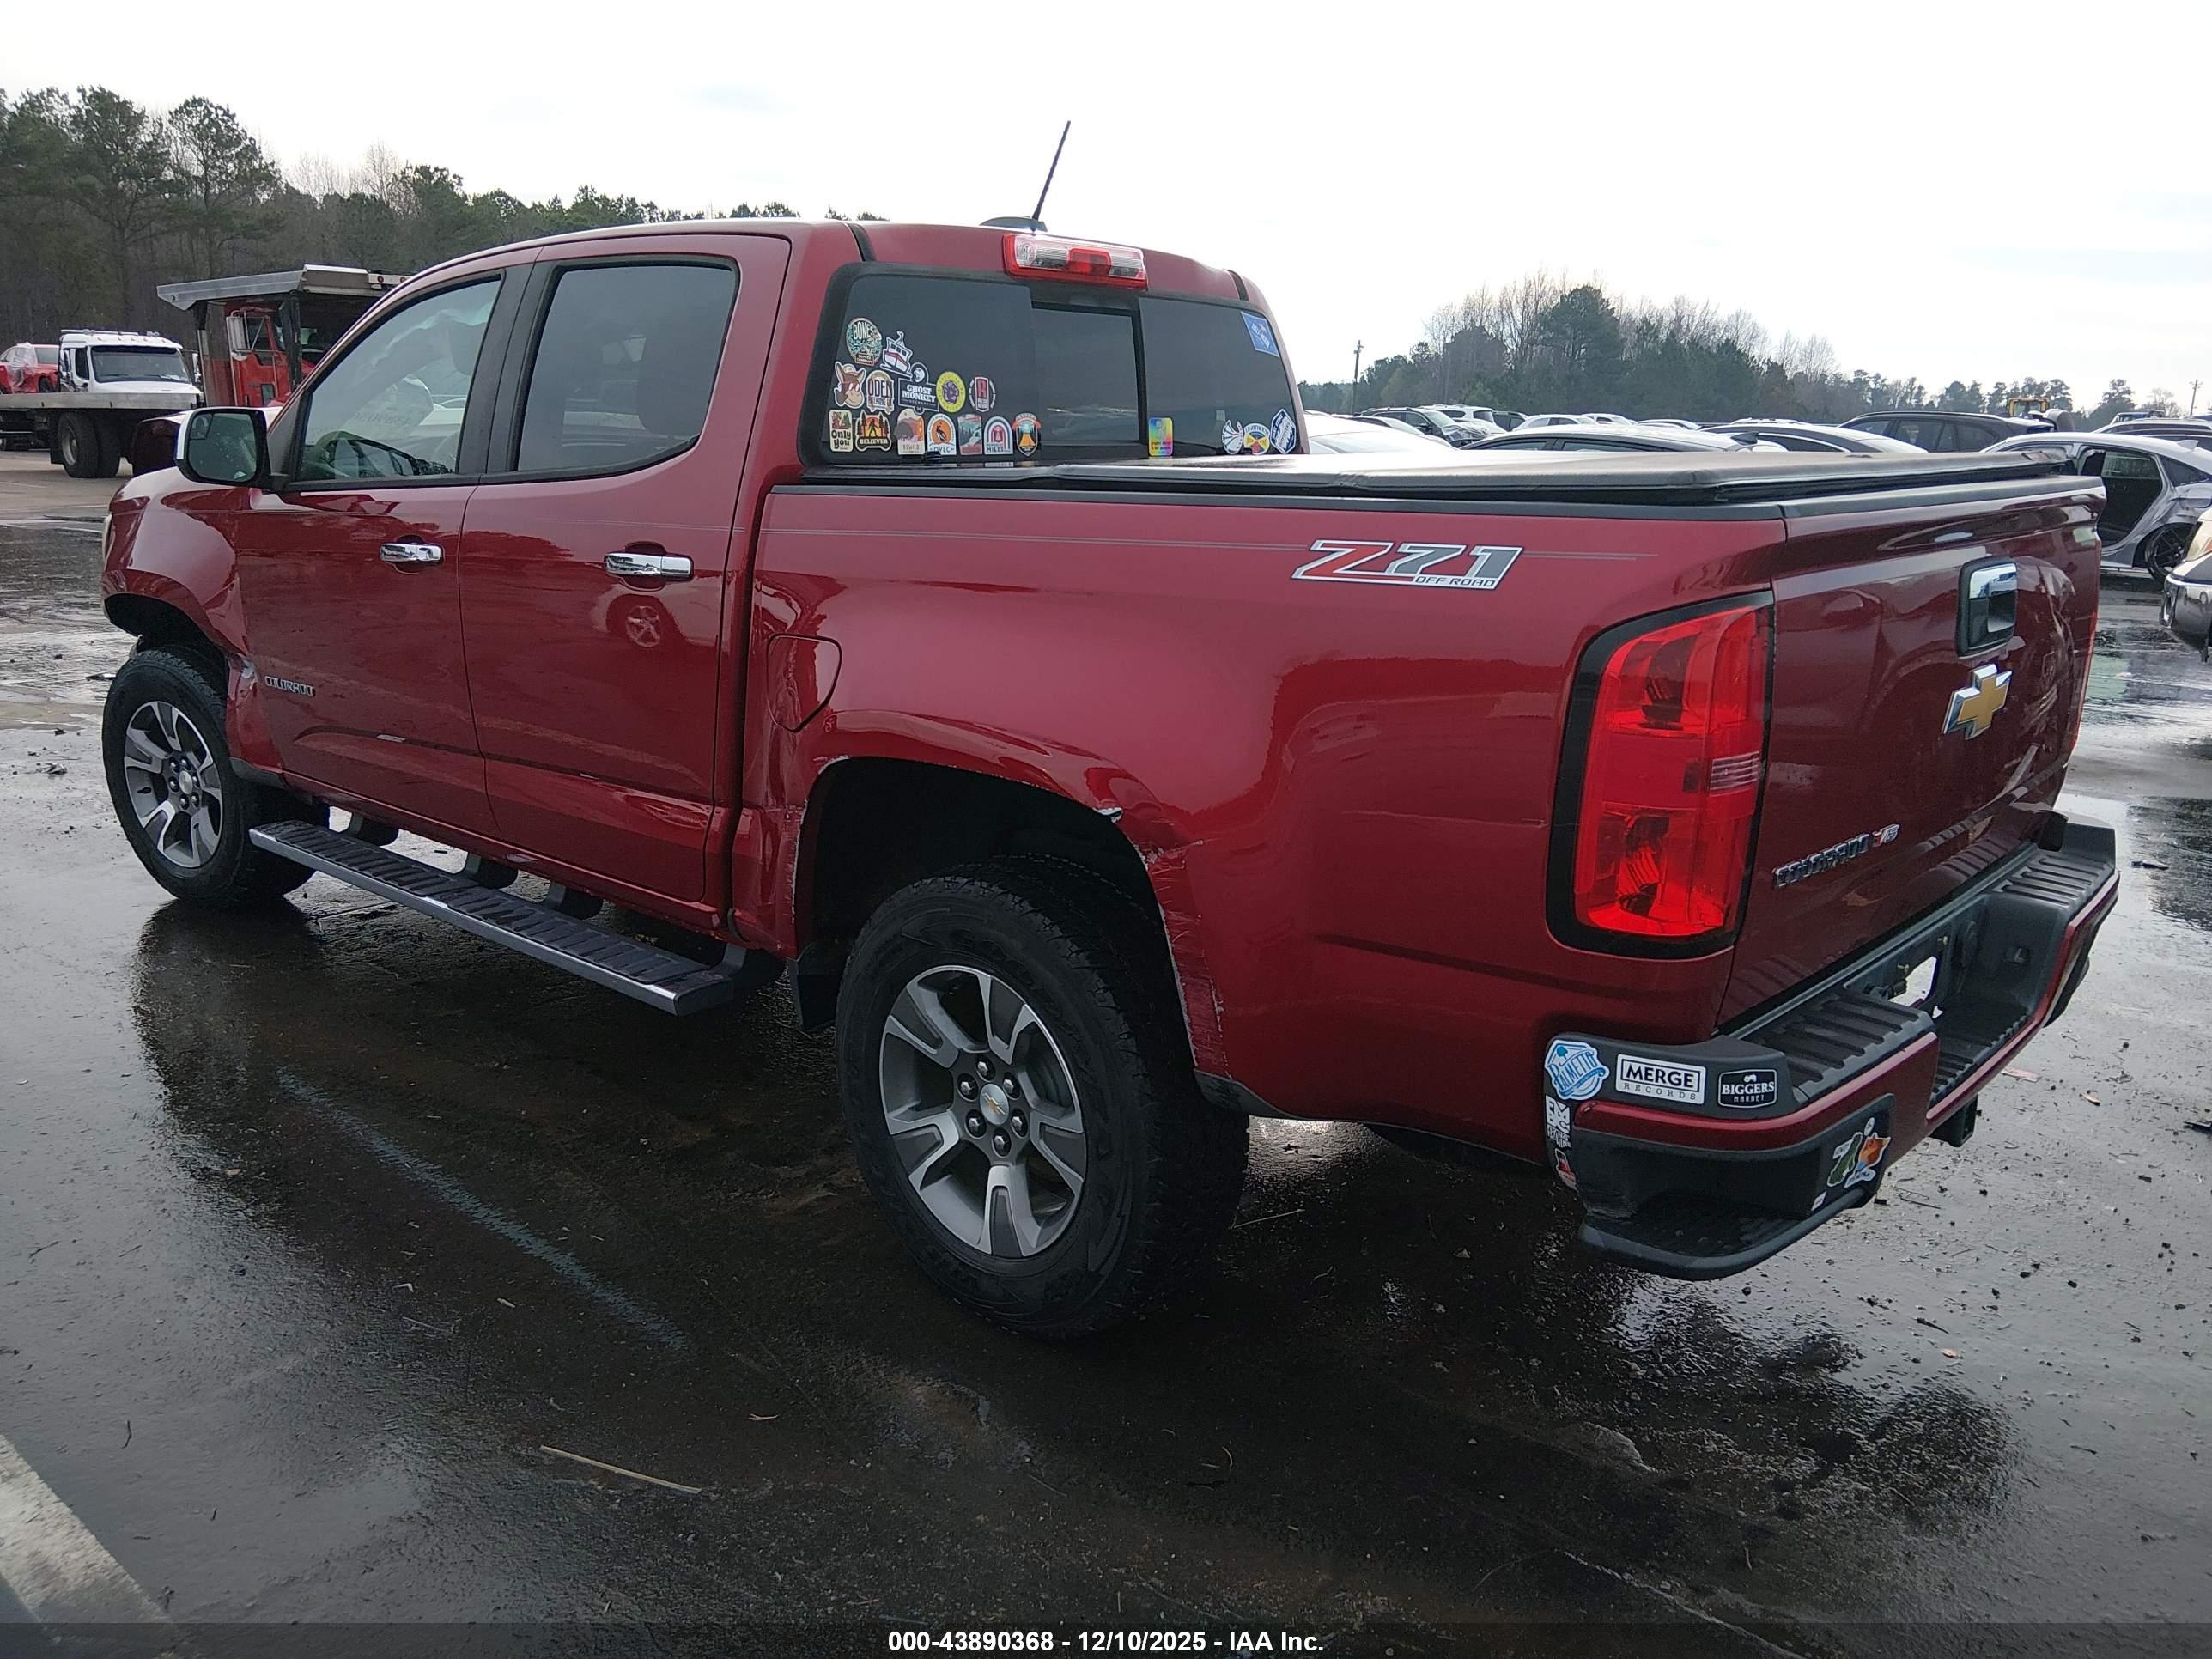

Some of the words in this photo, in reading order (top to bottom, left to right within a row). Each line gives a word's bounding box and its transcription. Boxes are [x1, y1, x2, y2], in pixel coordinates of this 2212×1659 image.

[853, 321, 874, 340] BONES
[902, 390, 936, 403] MONKEY
[907, 384, 932, 395] GHOST
[831, 429, 851, 440] Only
[834, 439, 850, 449] you
[1291, 539, 1523, 589] Z71
[1414, 575, 1447, 585] OFF
[1449, 578, 1497, 588] ROAD
[264, 675, 315, 696] COLORADO
[1548, 1052, 1597, 1091] PALMETTO
[1626, 1063, 1694, 1089] MERGE
[1624, 1082, 1697, 1100] RECORDS
[1722, 1081, 1775, 1095] BIGGERS
